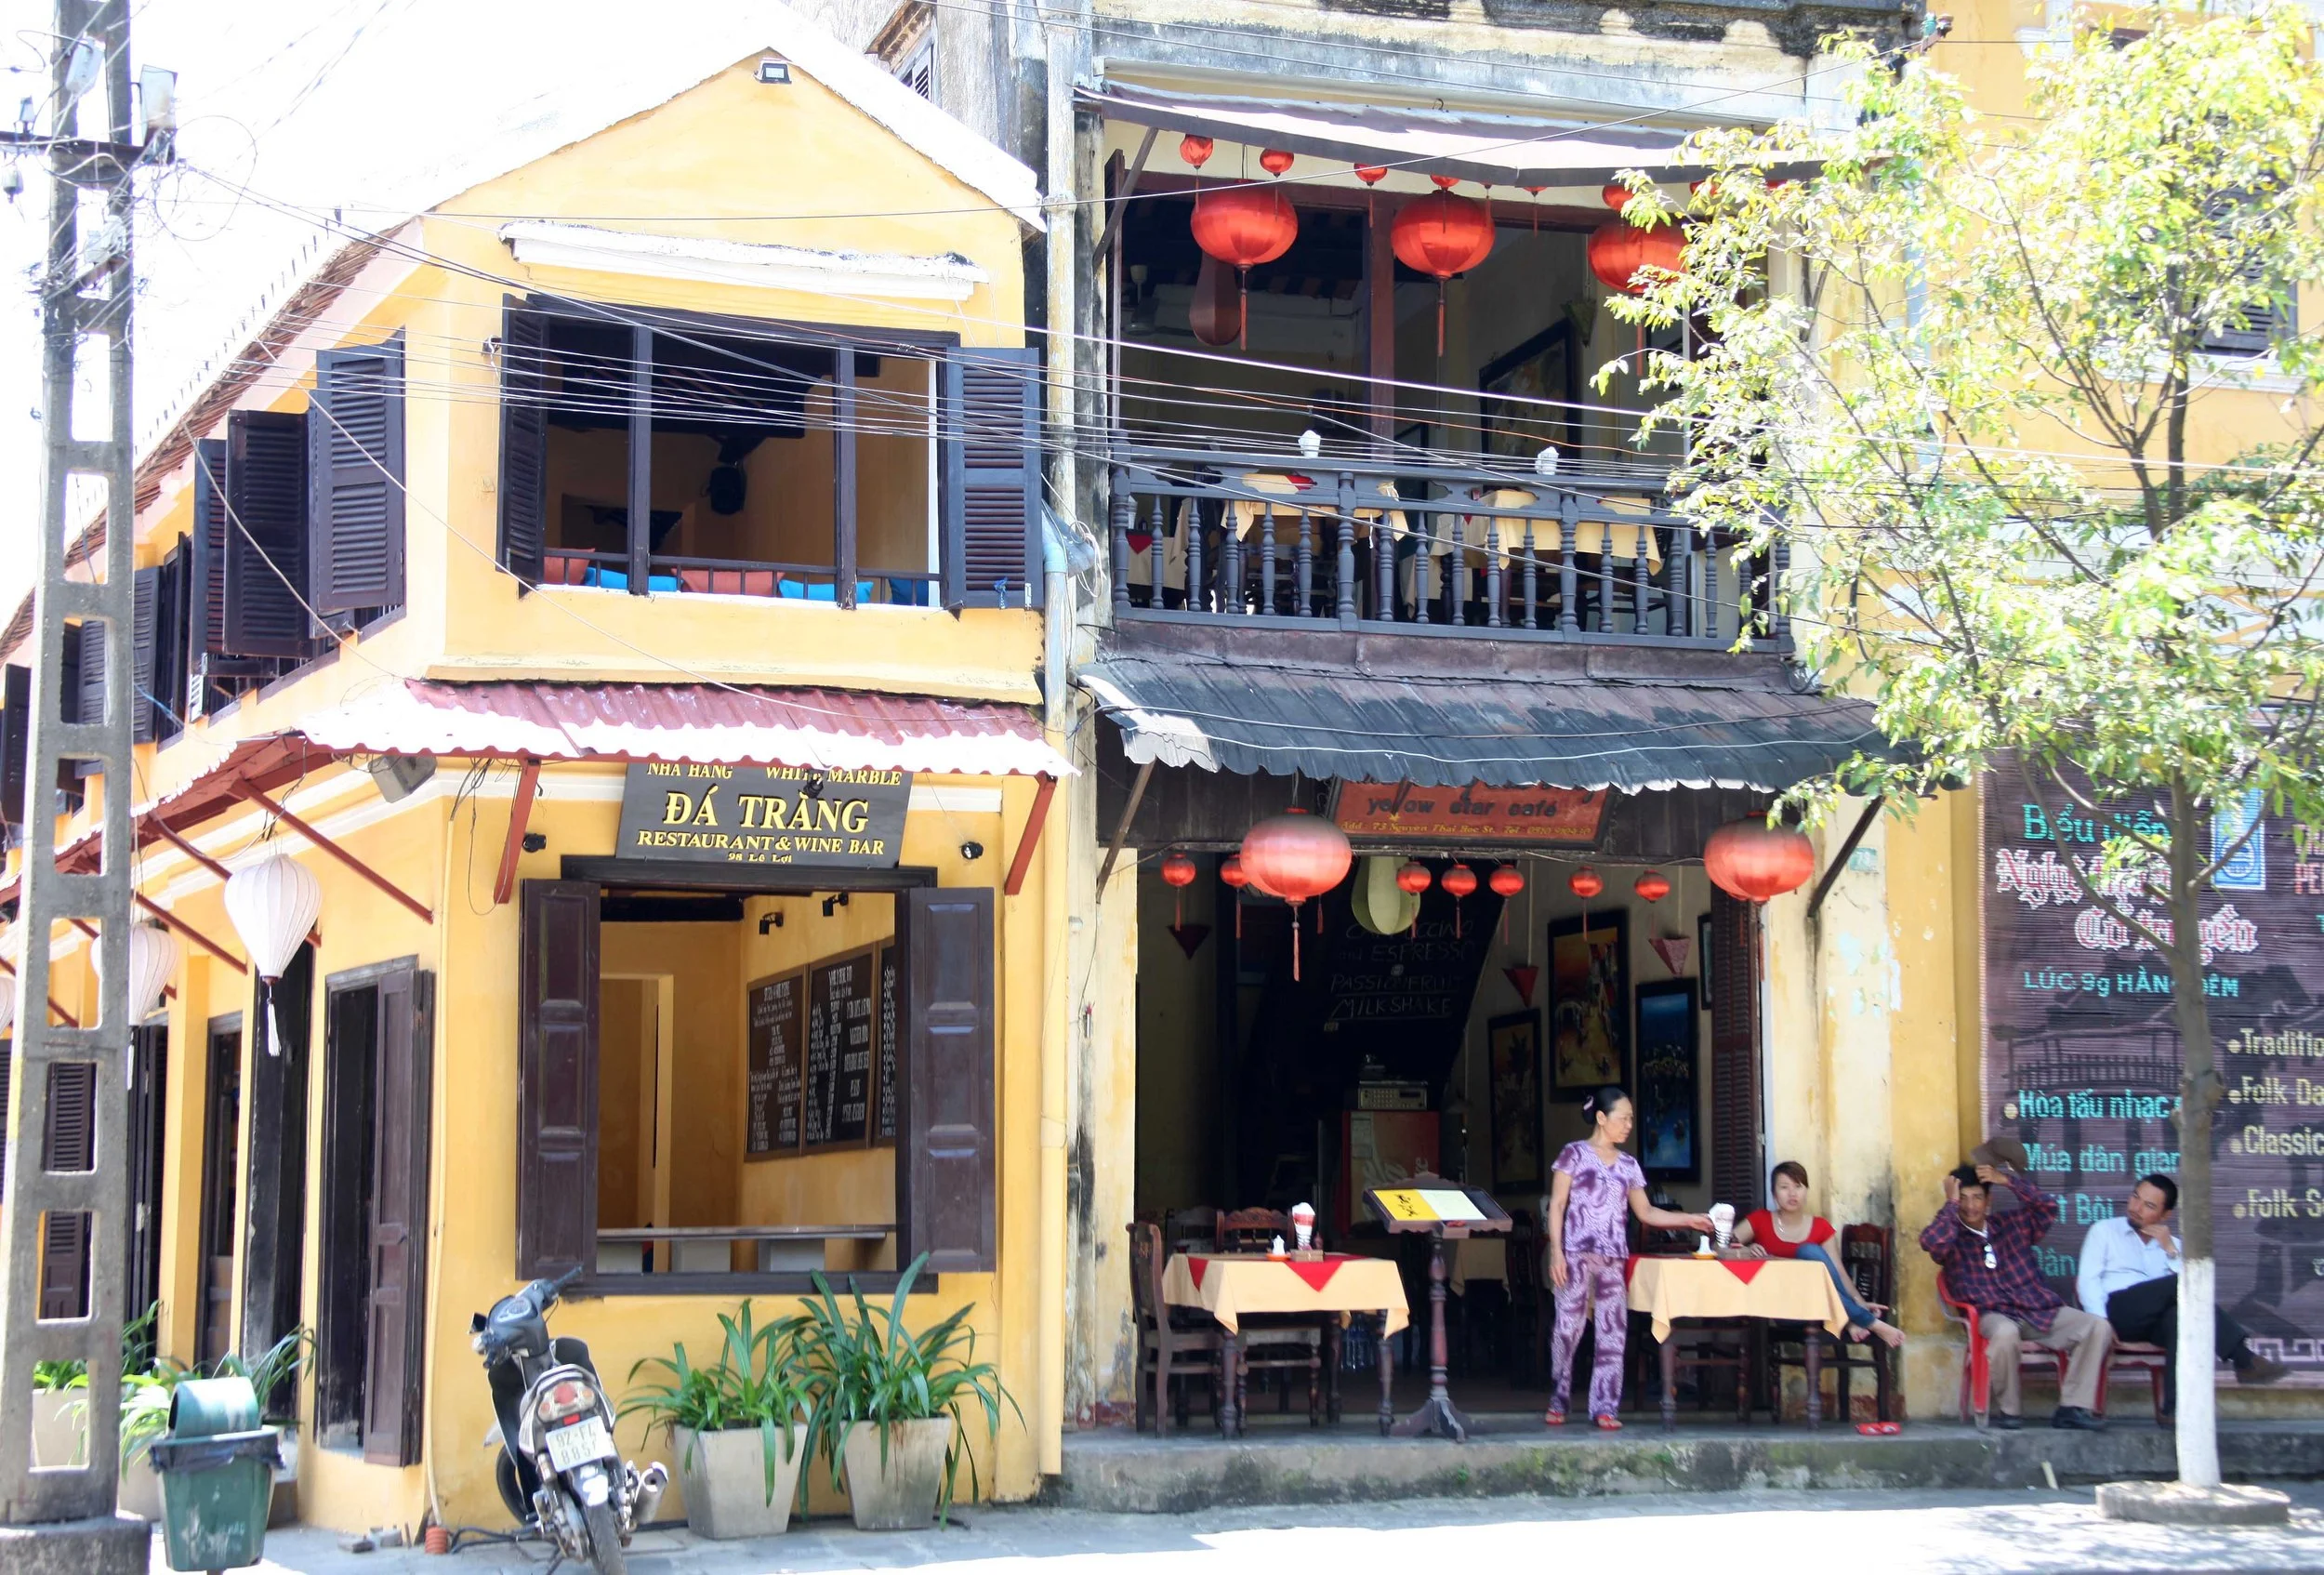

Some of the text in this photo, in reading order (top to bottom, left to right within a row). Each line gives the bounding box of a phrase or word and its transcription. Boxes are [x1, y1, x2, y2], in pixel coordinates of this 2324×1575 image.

[827, 769, 903, 787] MARBLE
[637, 830, 884, 855] RESTAURANT & WINE BAR
[2241, 1075, 2290, 1105] Folk
[2109, 1088, 2171, 1124] nhạc
[2243, 1124, 2324, 1157] Classic
[2247, 1188, 2299, 1218] Folk
